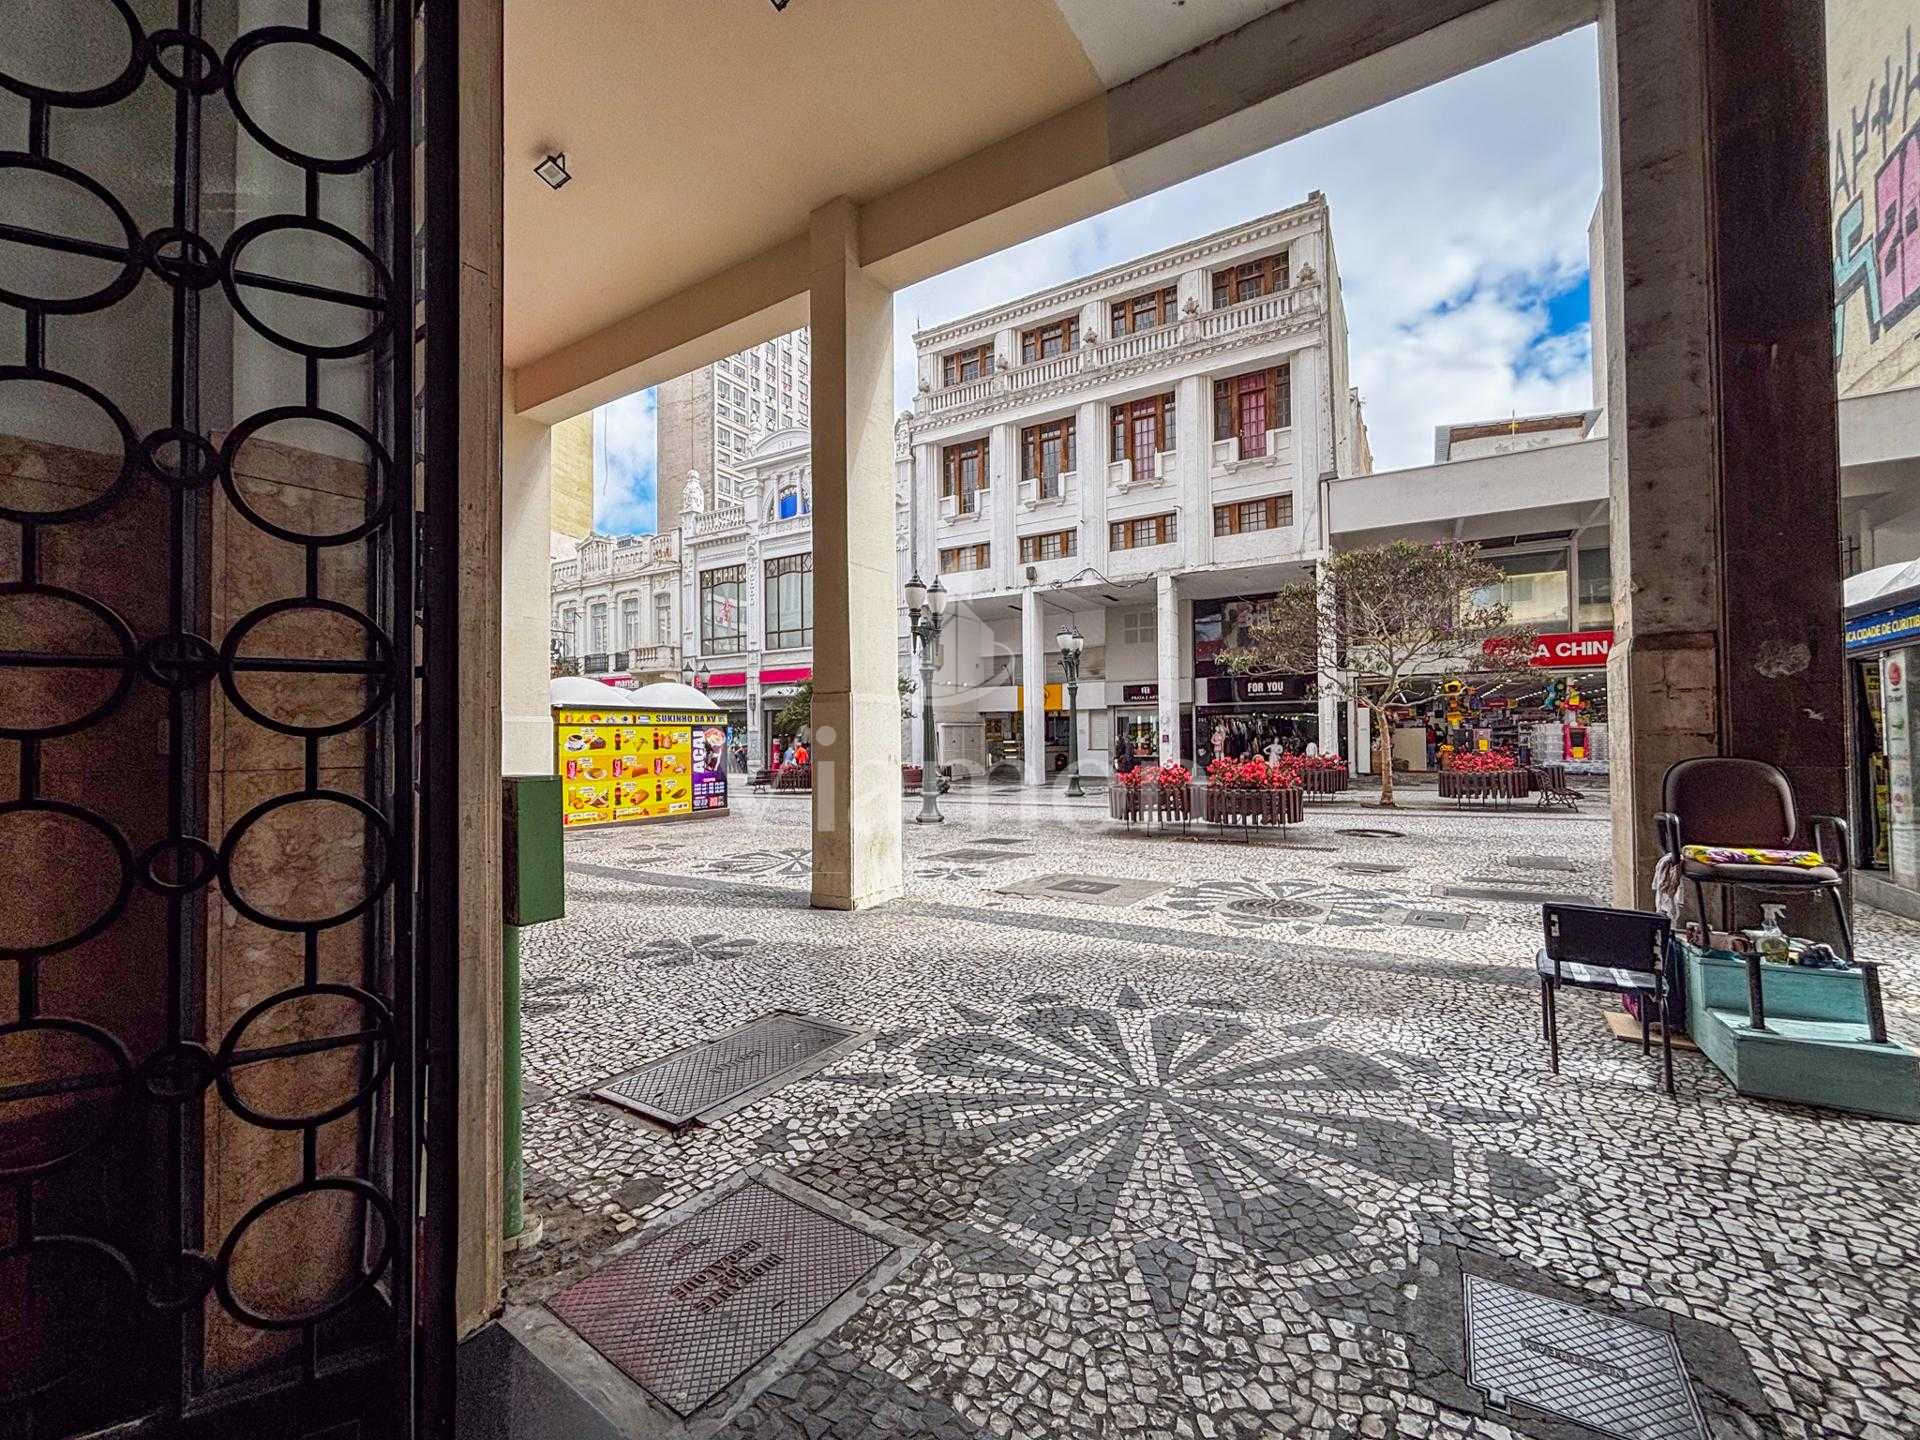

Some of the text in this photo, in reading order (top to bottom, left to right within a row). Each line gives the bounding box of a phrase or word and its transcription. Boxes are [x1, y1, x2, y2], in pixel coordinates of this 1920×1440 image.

[1881, 622, 1892, 635] DE
[1555, 640, 1609, 657] CHIN
[1247, 681, 1284, 692] FOR YOU
[655, 713, 693, 723] SUKINHO
[694, 714, 705, 723] DA
[706, 714, 717, 723] XV
[716, 1265, 747, 1285] DE
[693, 1253, 785, 1314] HIDRANTE
